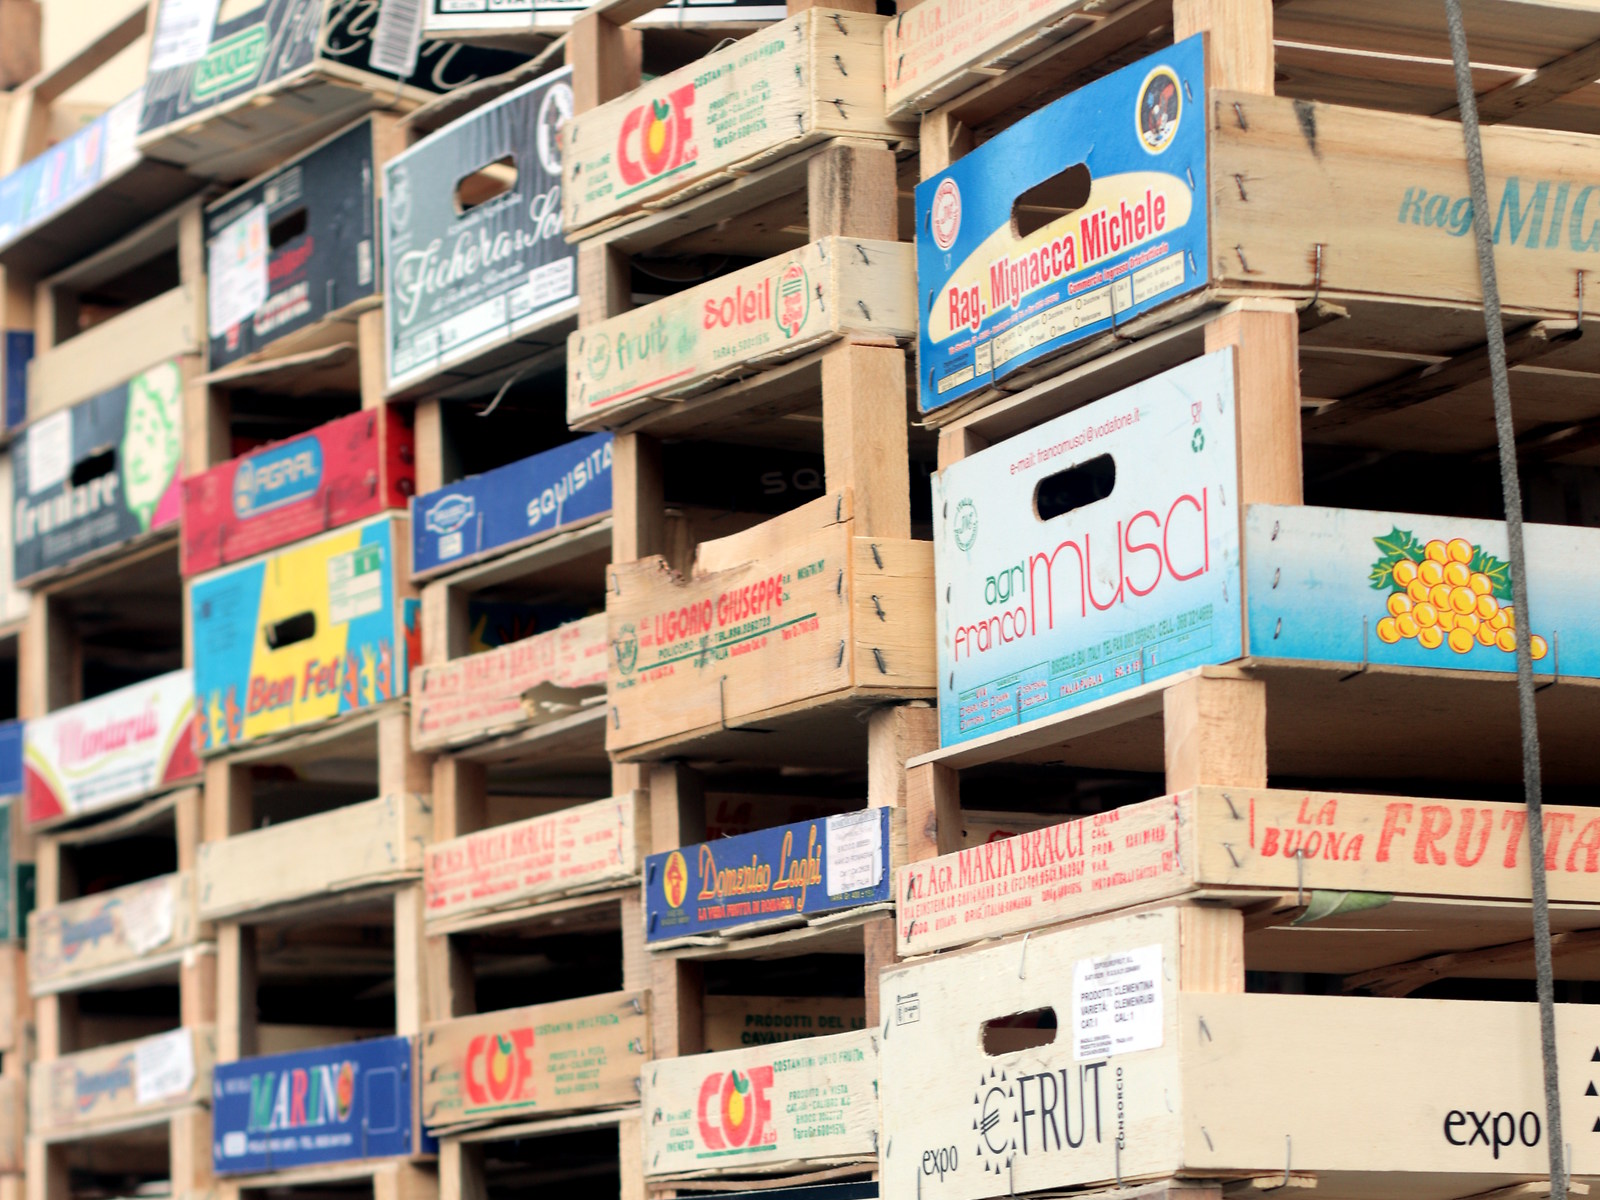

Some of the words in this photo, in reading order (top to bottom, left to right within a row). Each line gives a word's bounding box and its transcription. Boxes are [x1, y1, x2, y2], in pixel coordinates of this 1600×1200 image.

[948, 282, 986, 332] Rag.
[989, 231, 1077, 309] Mignacca
[1080, 189, 1167, 265] Michele
[616, 314, 668, 370] fruit
[704, 277, 771, 330] soleil
[654, 599, 713, 647] LIGORIO
[716, 573, 784, 627] GIUSEPPE
[985, 560, 1027, 606] agri
[955, 605, 1028, 662] franco
[248, 673, 296, 716] Ben
[302, 653, 342, 704] Fet
[1297, 797, 1338, 826] LA
[697, 843, 771, 901] Domenico
[772, 824, 822, 912] Laghi
[1020, 818, 1084, 872] BRACCI
[1261, 827, 1365, 862] BUONA
[818, 1015, 844, 1028] DEL
[698, 1065, 774, 1150] COF
[1444, 1110, 1541, 1160] expo
[922, 1145, 958, 1183] expo
